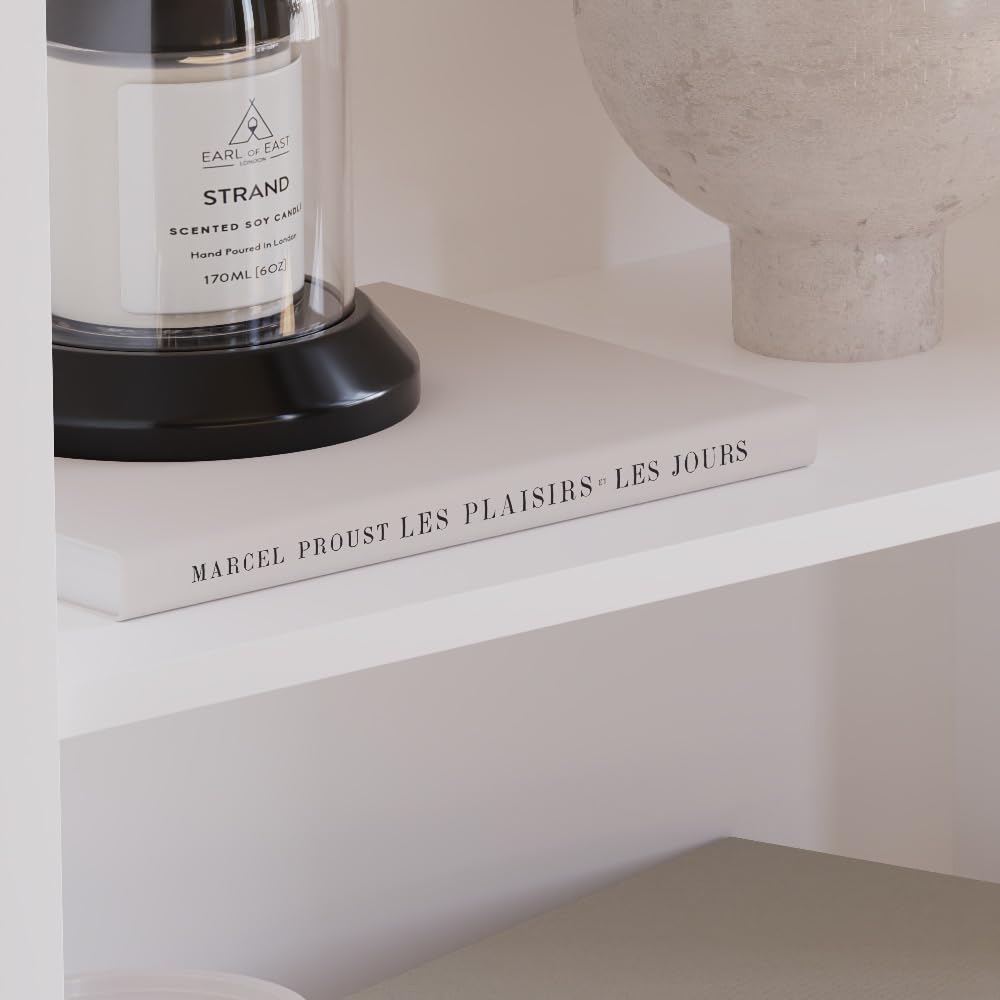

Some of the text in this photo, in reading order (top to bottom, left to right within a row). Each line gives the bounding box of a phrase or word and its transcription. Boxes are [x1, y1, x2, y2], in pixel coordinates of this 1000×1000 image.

[202, 136, 290, 163] EARL OF EAST
[203, 176, 290, 206] STRAND
[169, 223, 239, 236] SCENTED
[245, 216, 270, 229] SOY
[190, 249, 222, 260] Hand
[225, 243, 261, 256] Poured
[204, 270, 252, 285] 170ML
[191, 546, 285, 583] MARCEL
[298, 522, 389, 559] PROUST
[400, 508, 449, 539] LES
[464, 475, 593, 524] PLAISIRS
[615, 460, 660, 489] LES
[672, 440, 749, 476] JOURS
